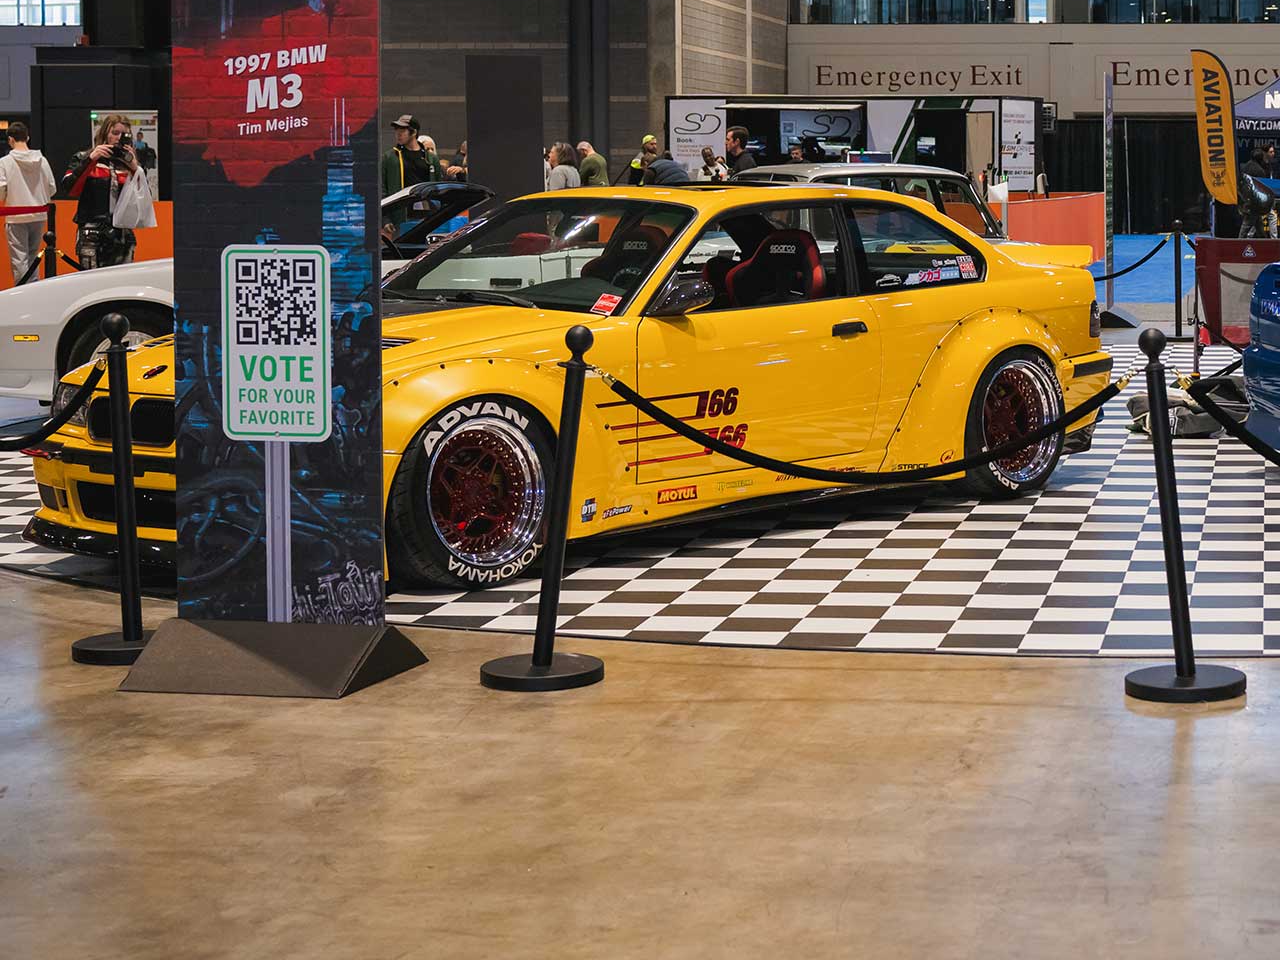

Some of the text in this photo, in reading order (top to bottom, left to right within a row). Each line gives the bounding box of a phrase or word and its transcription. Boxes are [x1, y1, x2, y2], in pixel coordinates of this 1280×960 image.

[224, 44, 327, 75] 1997 BMW
[816, 64, 1023, 91] Emergency Exit
[246, 73, 303, 113] M3
[237, 116, 309, 135] Tim Mejias
[1202, 68, 1227, 163] AVIATION
[623, 241, 648, 249] sparco
[770, 245, 796, 253] sparco
[239, 355, 314, 382] VOTE
[1037, 356, 1062, 401] YOKOHAMA
[239, 388, 315, 404] FOR YOUR
[240, 410, 315, 426] FAVORITE
[423, 401, 529, 458] ADVAN
[658, 487, 698, 503] MOTUL
[448, 542, 543, 583] YOKOHAMA
